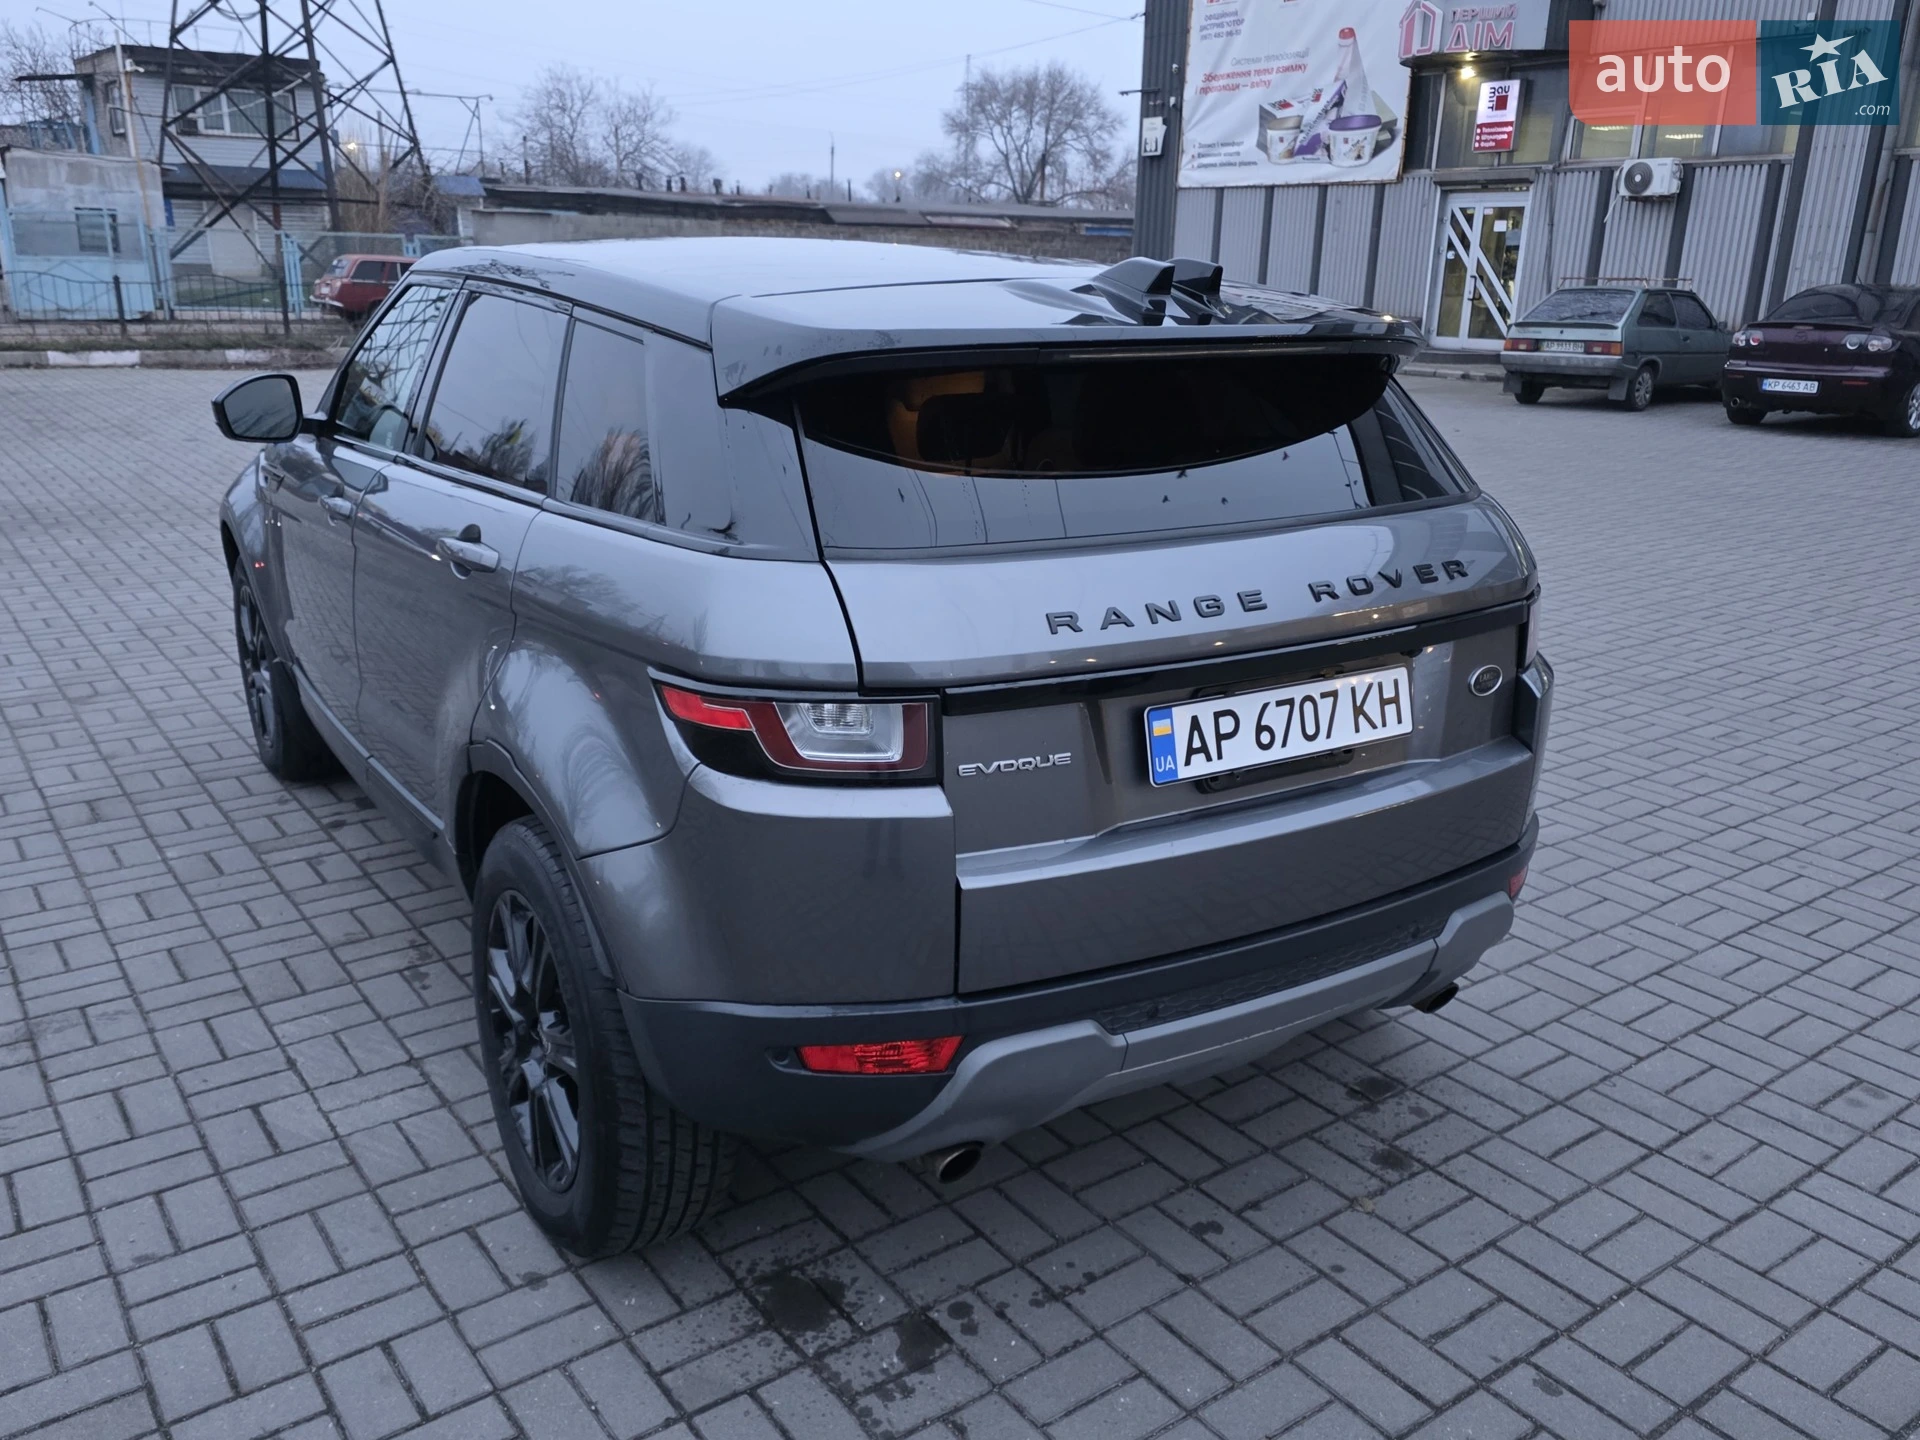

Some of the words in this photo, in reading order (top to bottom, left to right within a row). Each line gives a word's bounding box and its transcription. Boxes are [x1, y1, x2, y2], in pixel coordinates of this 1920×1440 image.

[1451, 4, 1519, 23] ПЕРШИЙ
[1444, 20, 1515, 53] ДІМ
[1201, 69, 1251, 83] Збереження
[1253, 66, 1274, 77] тепла
[1275, 63, 1308, 75] взимку
[1768, 380, 1780, 390] KP
[1802, 382, 1816, 392] AB
[1045, 588, 1269, 636] RANGE
[1308, 559, 1470, 603] ROVER
[1183, 708, 1241, 767] AP
[1254, 688, 1340, 752] 6707
[1350, 677, 1404, 734] KH
[957, 752, 1072, 777] EVOQUE
[1155, 754, 1177, 774] UA
